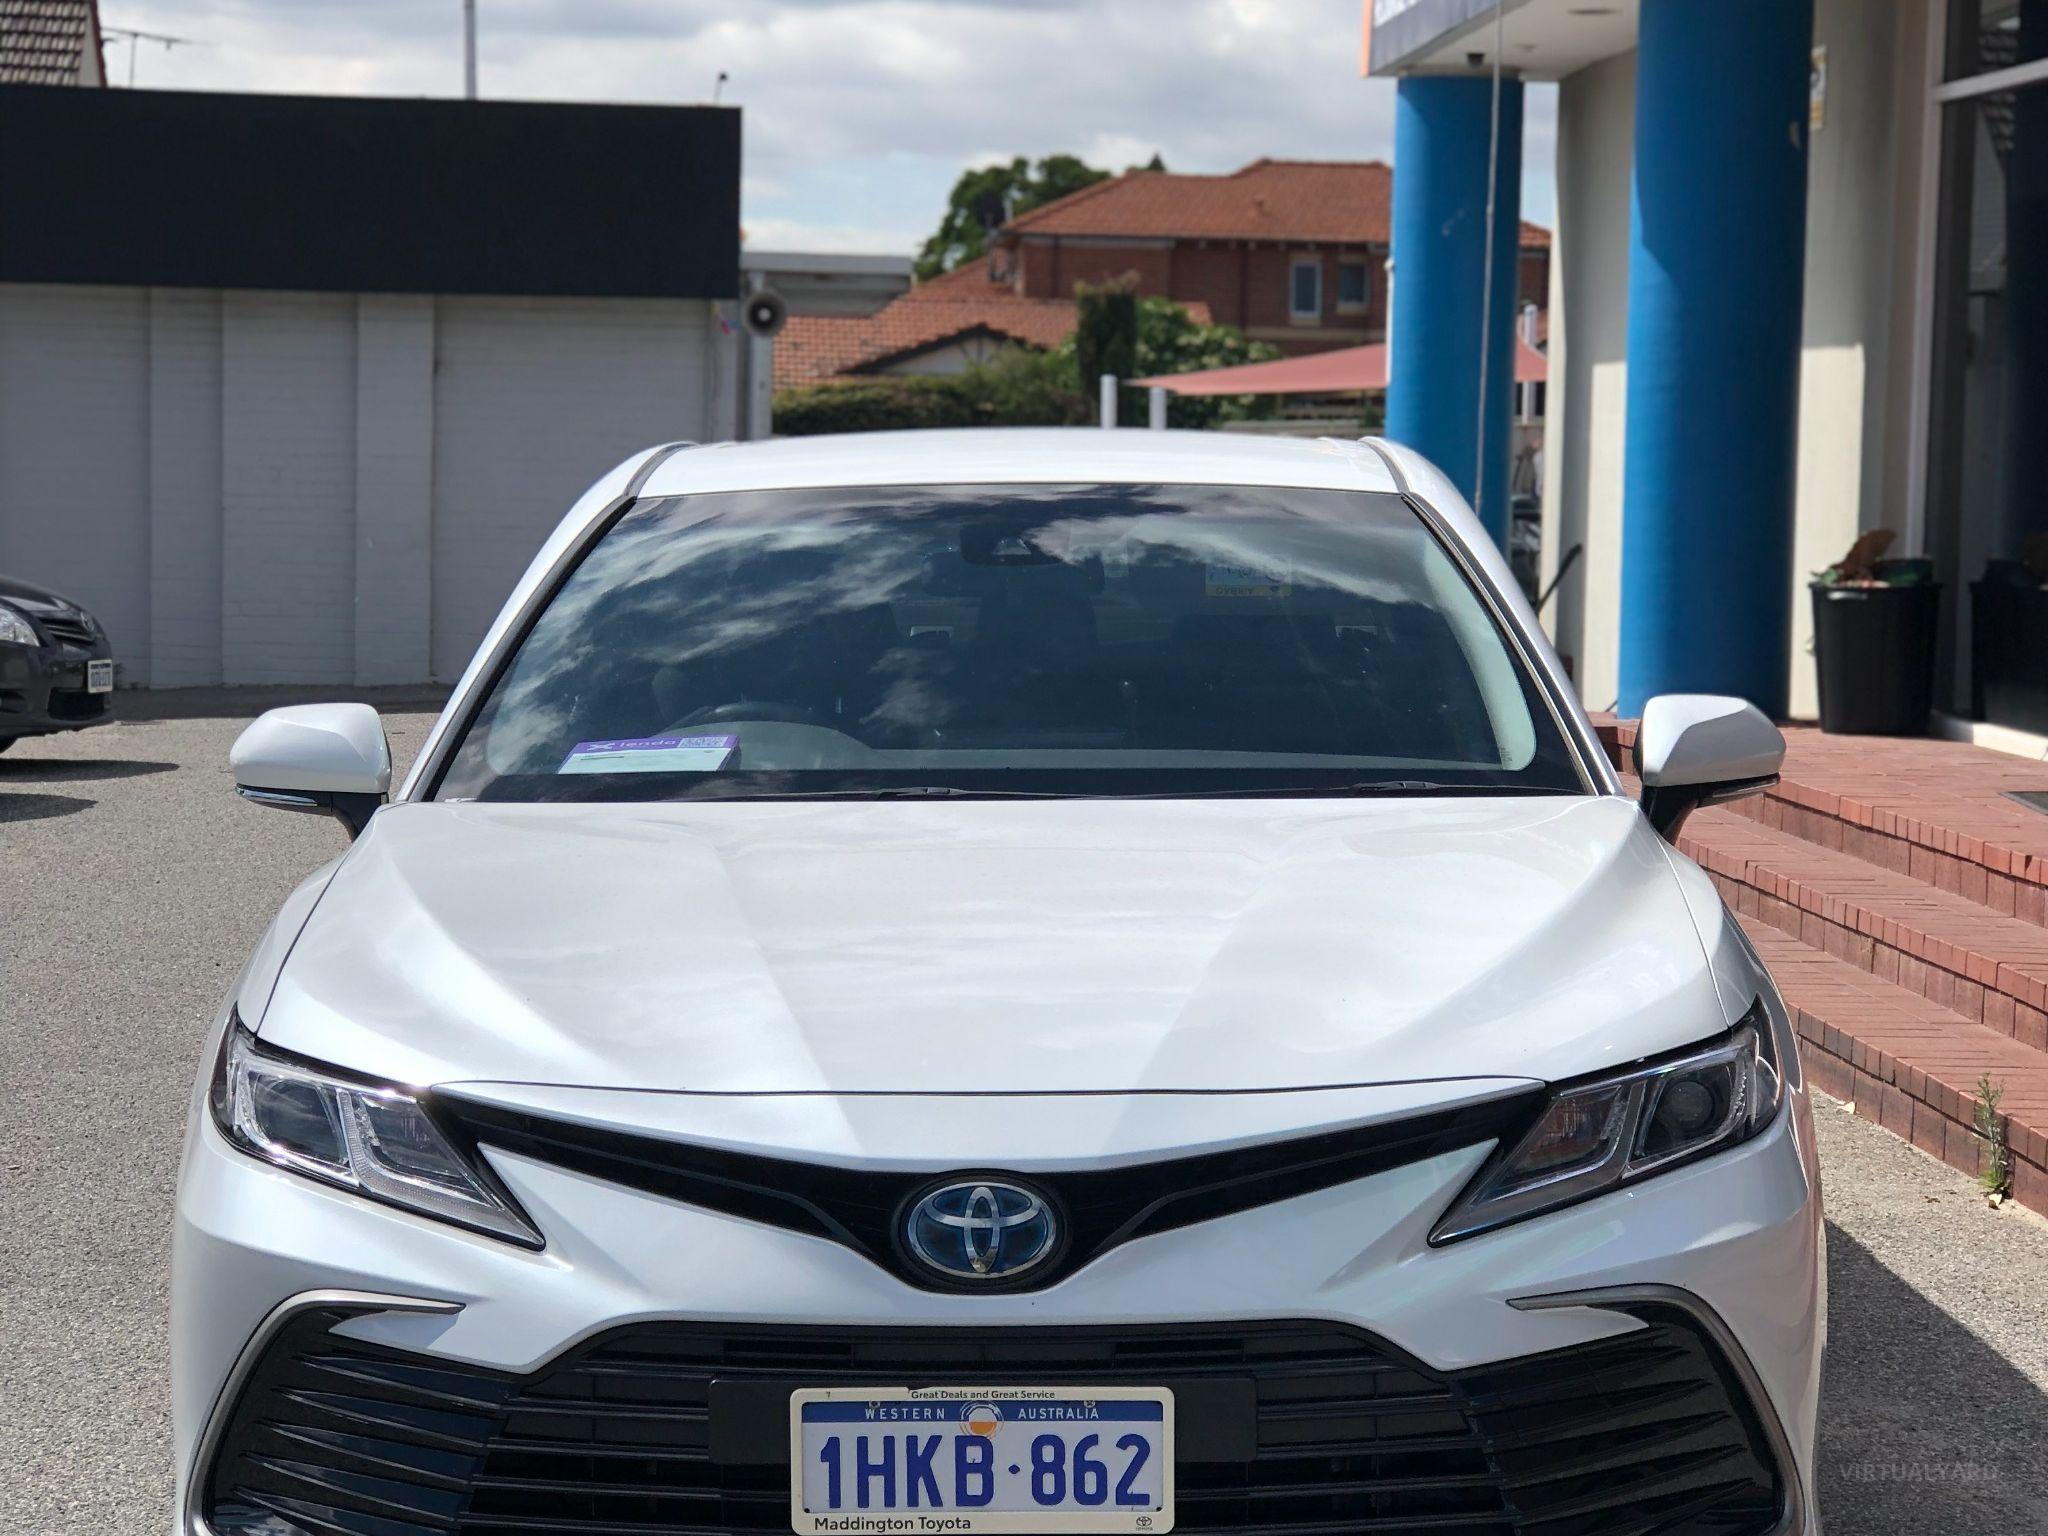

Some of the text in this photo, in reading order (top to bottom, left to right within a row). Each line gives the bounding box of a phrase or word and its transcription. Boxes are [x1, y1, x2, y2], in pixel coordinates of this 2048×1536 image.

[911, 1390, 1055, 1399] Great Deals and Great Service
[865, 1407, 1099, 1420] WESTERN AUSTRALIA
[814, 1516, 971, 1532] Maddington Toyota
